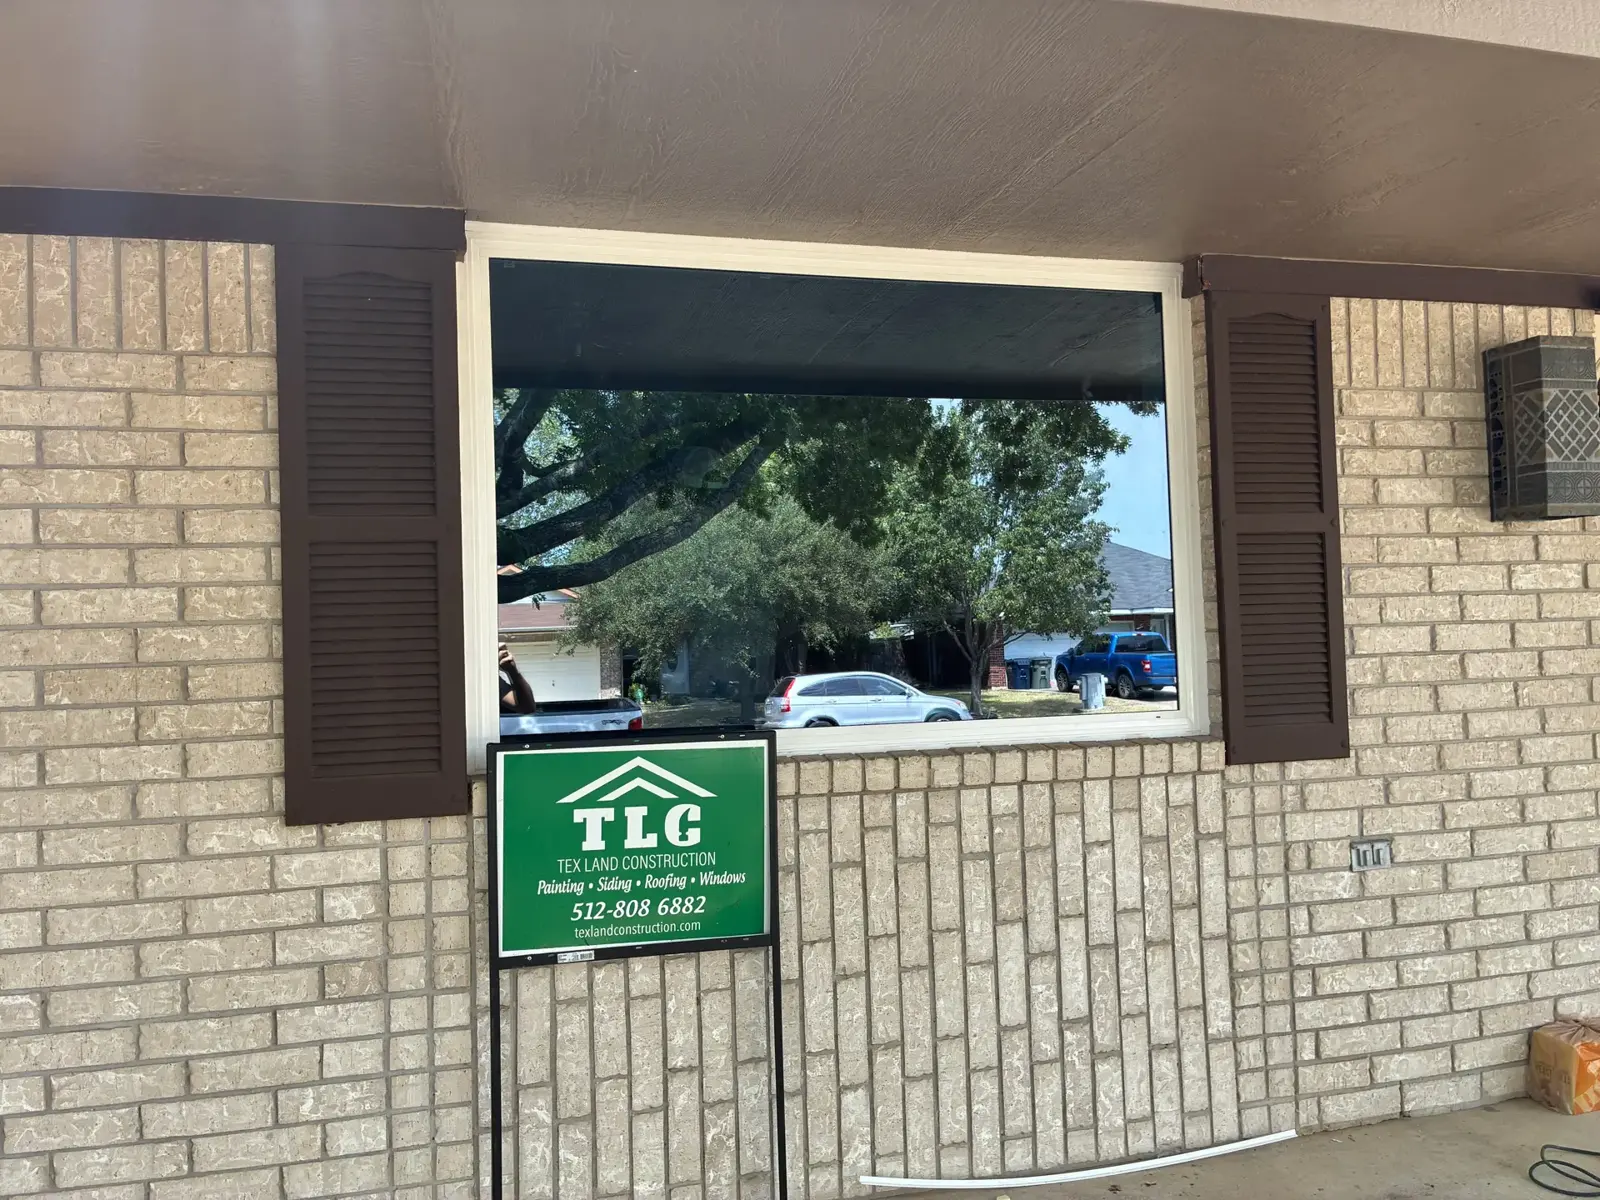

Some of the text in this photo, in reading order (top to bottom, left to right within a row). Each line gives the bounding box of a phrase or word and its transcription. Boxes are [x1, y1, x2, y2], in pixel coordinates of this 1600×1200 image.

[557, 851, 716, 874] TEX LAND CONSTRUCTION
[537, 870, 746, 896] Painting Siding Roofing Windows
[570, 895, 707, 922] 512-808 6882
[574, 921, 701, 939] texlandconstruction.com
